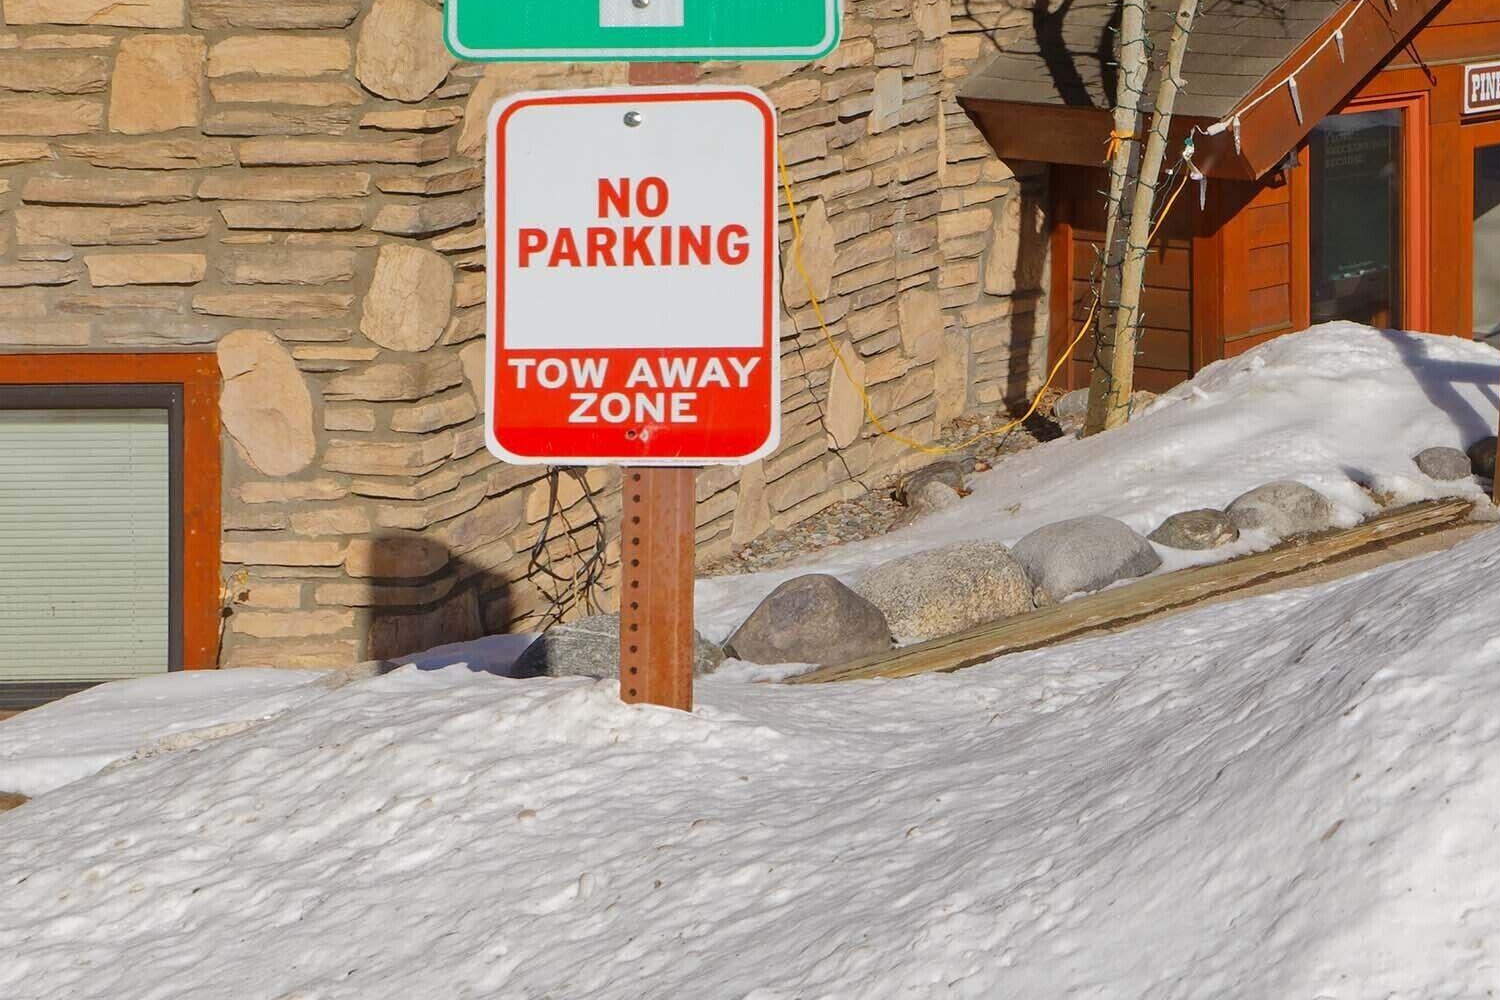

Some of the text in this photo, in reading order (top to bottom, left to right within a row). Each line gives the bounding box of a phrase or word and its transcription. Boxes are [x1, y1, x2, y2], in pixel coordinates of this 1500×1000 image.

[598, 176, 669, 219] NO
[518, 224, 750, 268] PARKING
[507, 357, 761, 389] TOW AWAY
[568, 392, 698, 424] ZONE
